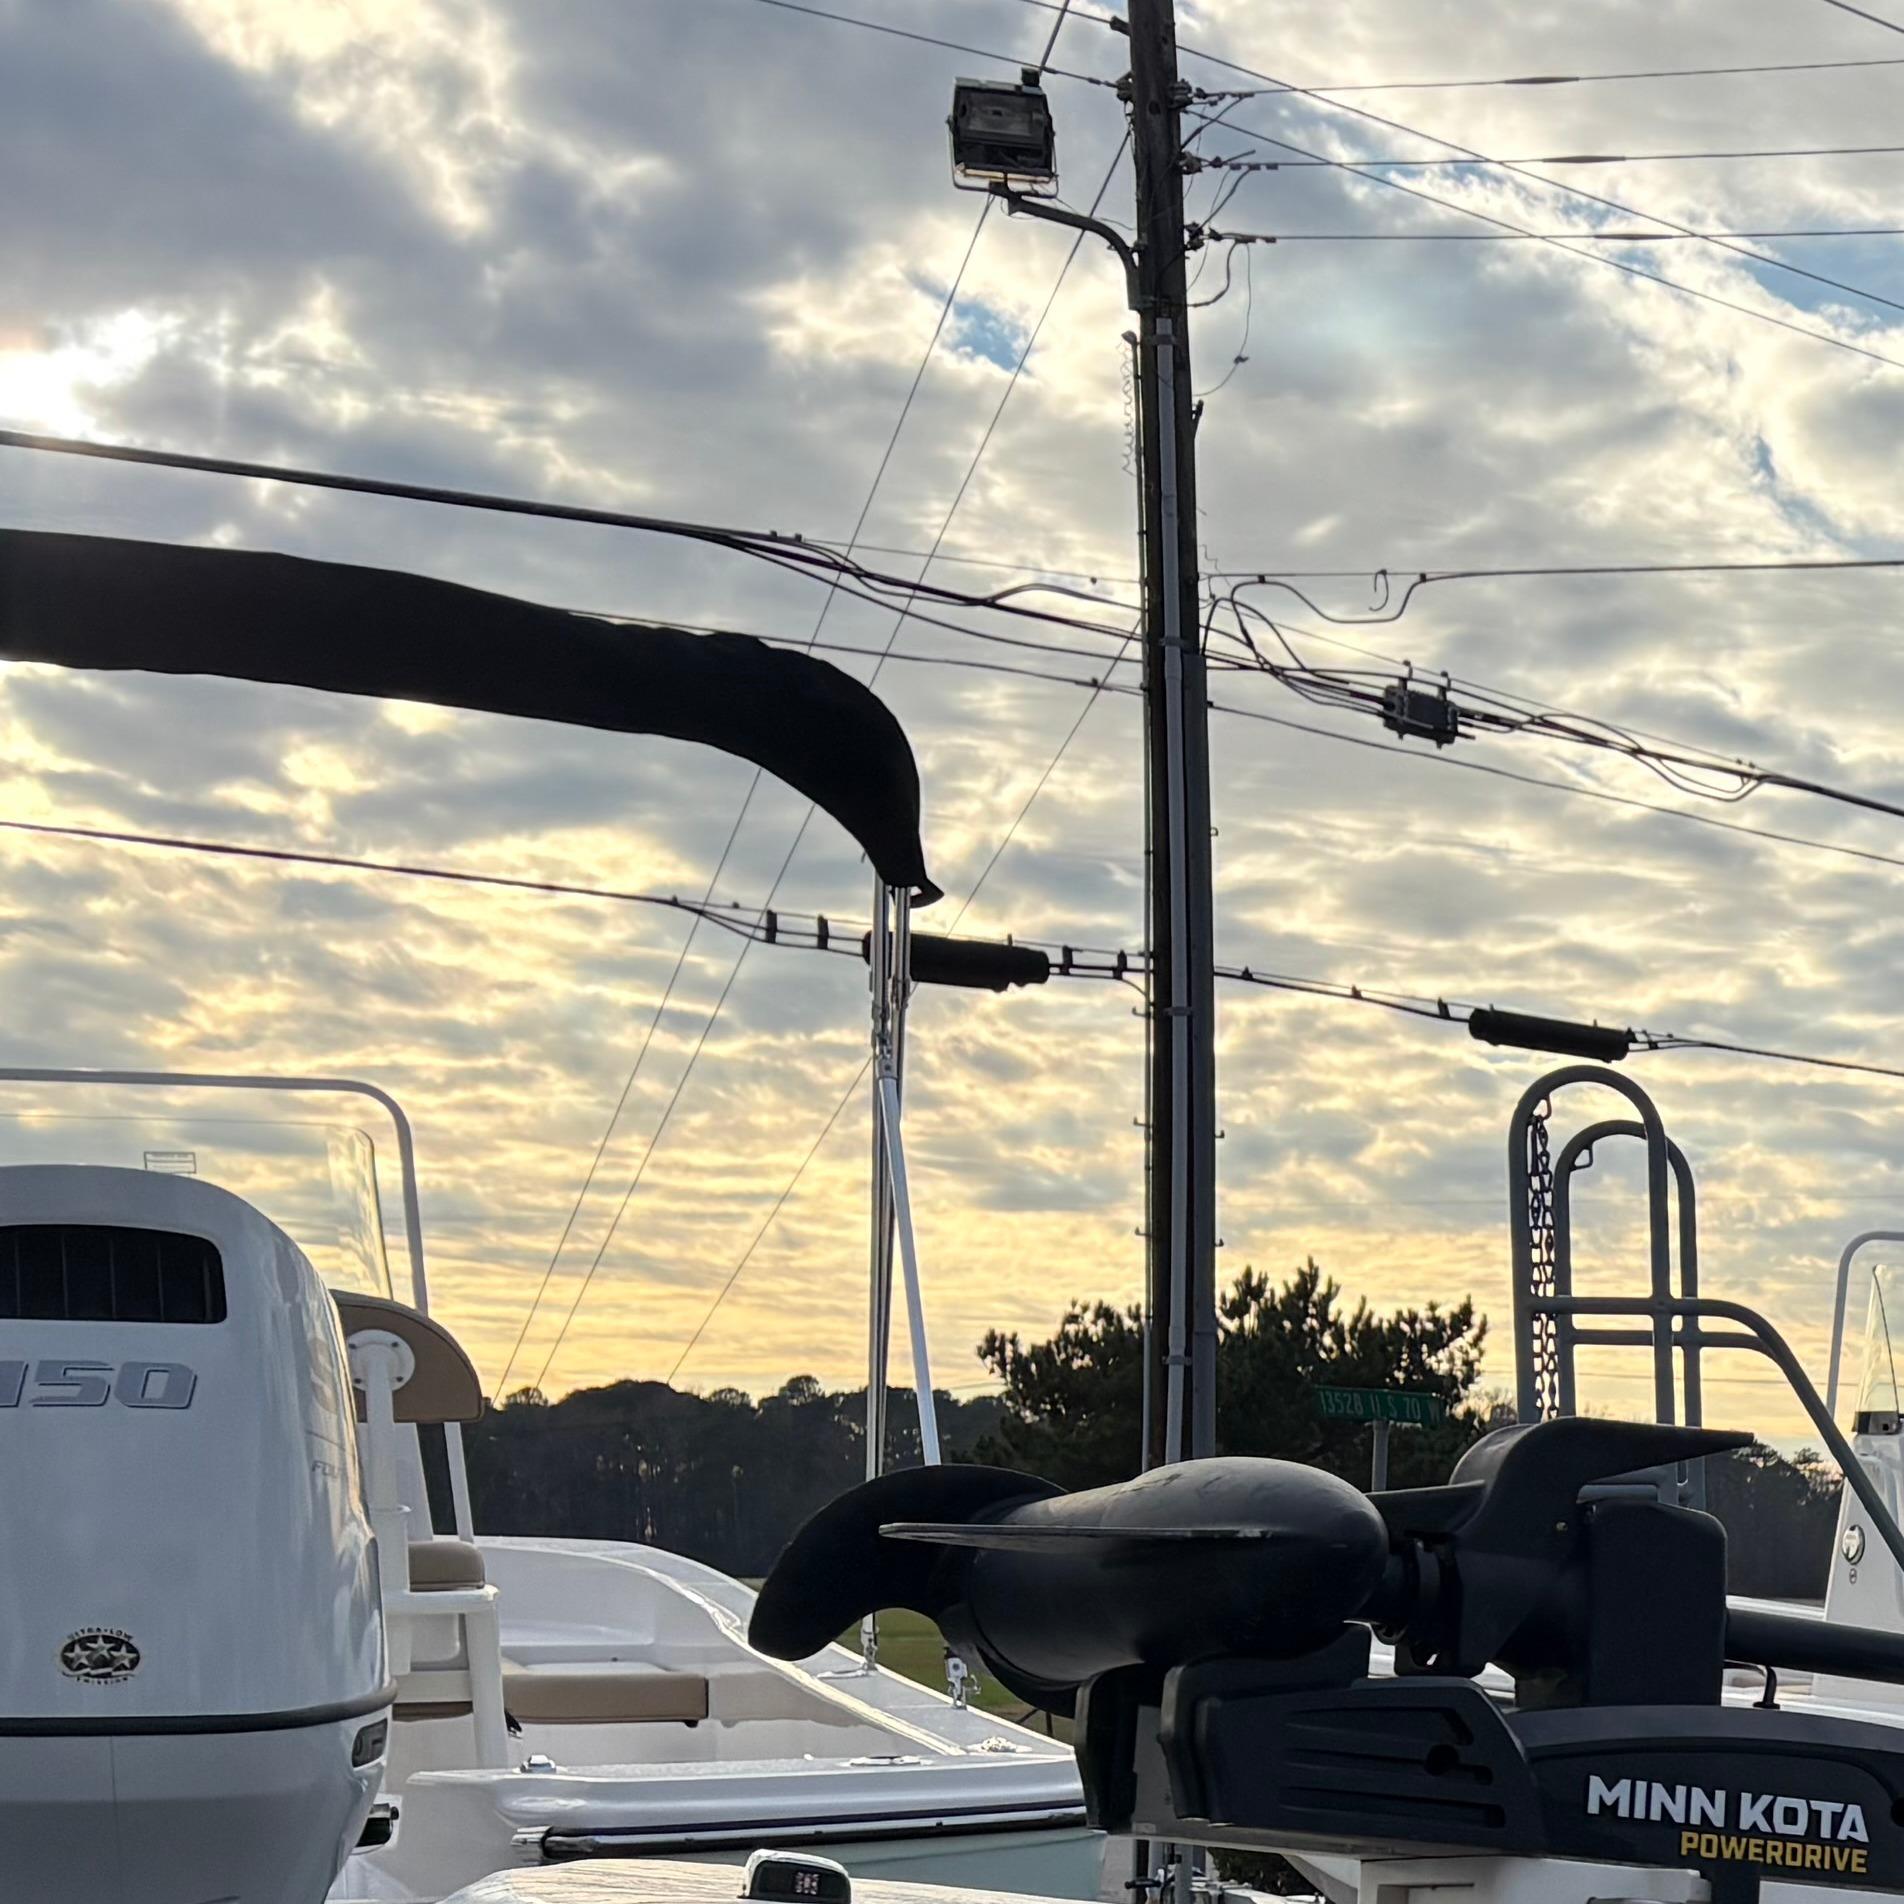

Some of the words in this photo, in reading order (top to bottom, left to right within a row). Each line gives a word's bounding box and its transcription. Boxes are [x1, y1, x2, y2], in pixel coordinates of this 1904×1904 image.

[1587, 1775, 1725, 1829] MINN
[1739, 1791, 1869, 1843] KOTA
[1680, 1831, 1867, 1873] POWERDRIVE
